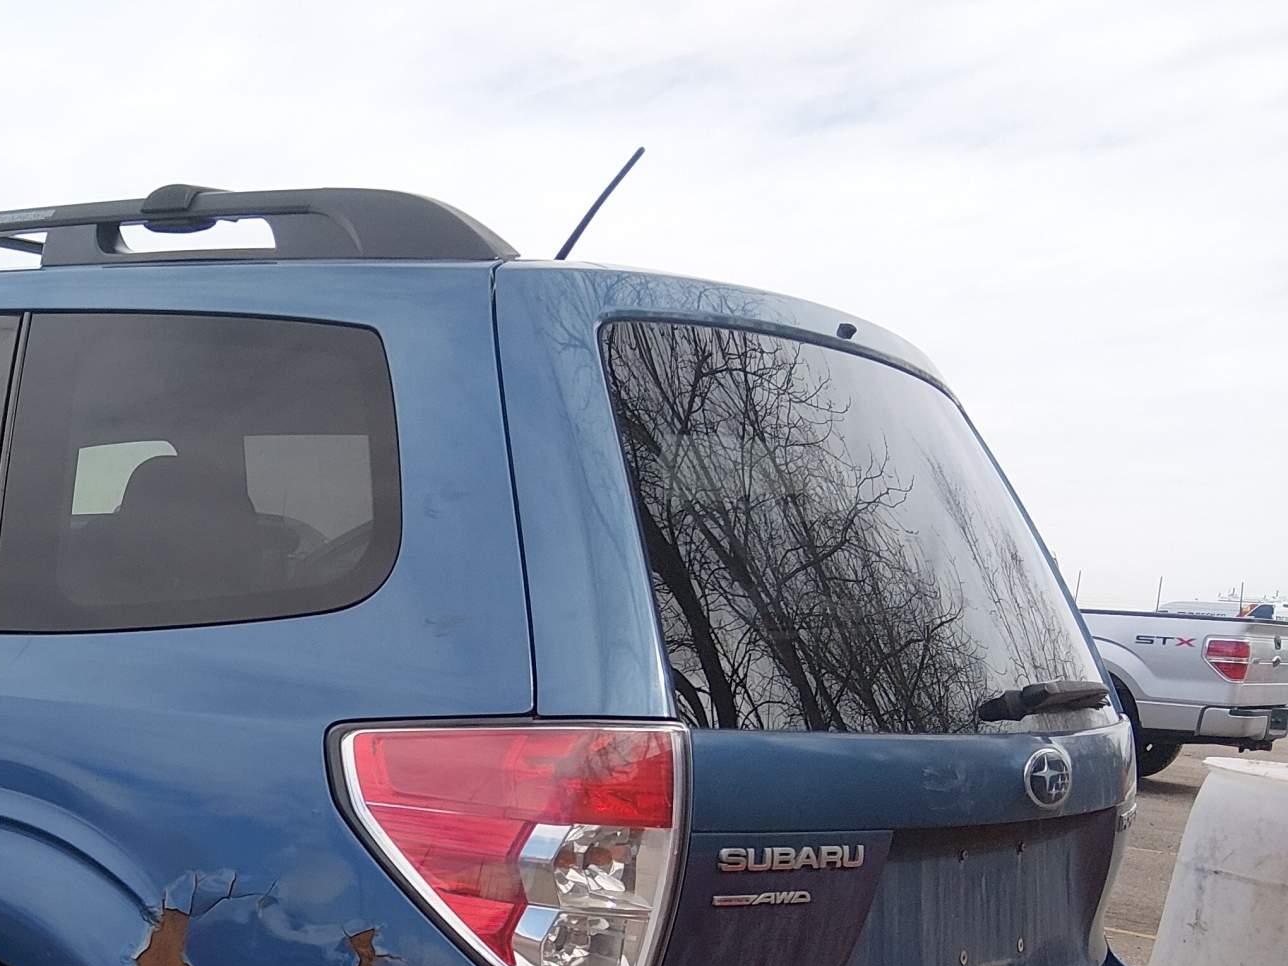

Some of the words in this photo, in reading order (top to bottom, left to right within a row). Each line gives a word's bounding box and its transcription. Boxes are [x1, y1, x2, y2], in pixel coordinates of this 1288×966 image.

[1135, 634, 1196, 648] STX
[718, 844, 865, 872] SUBARU
[752, 891, 811, 905] AWD
